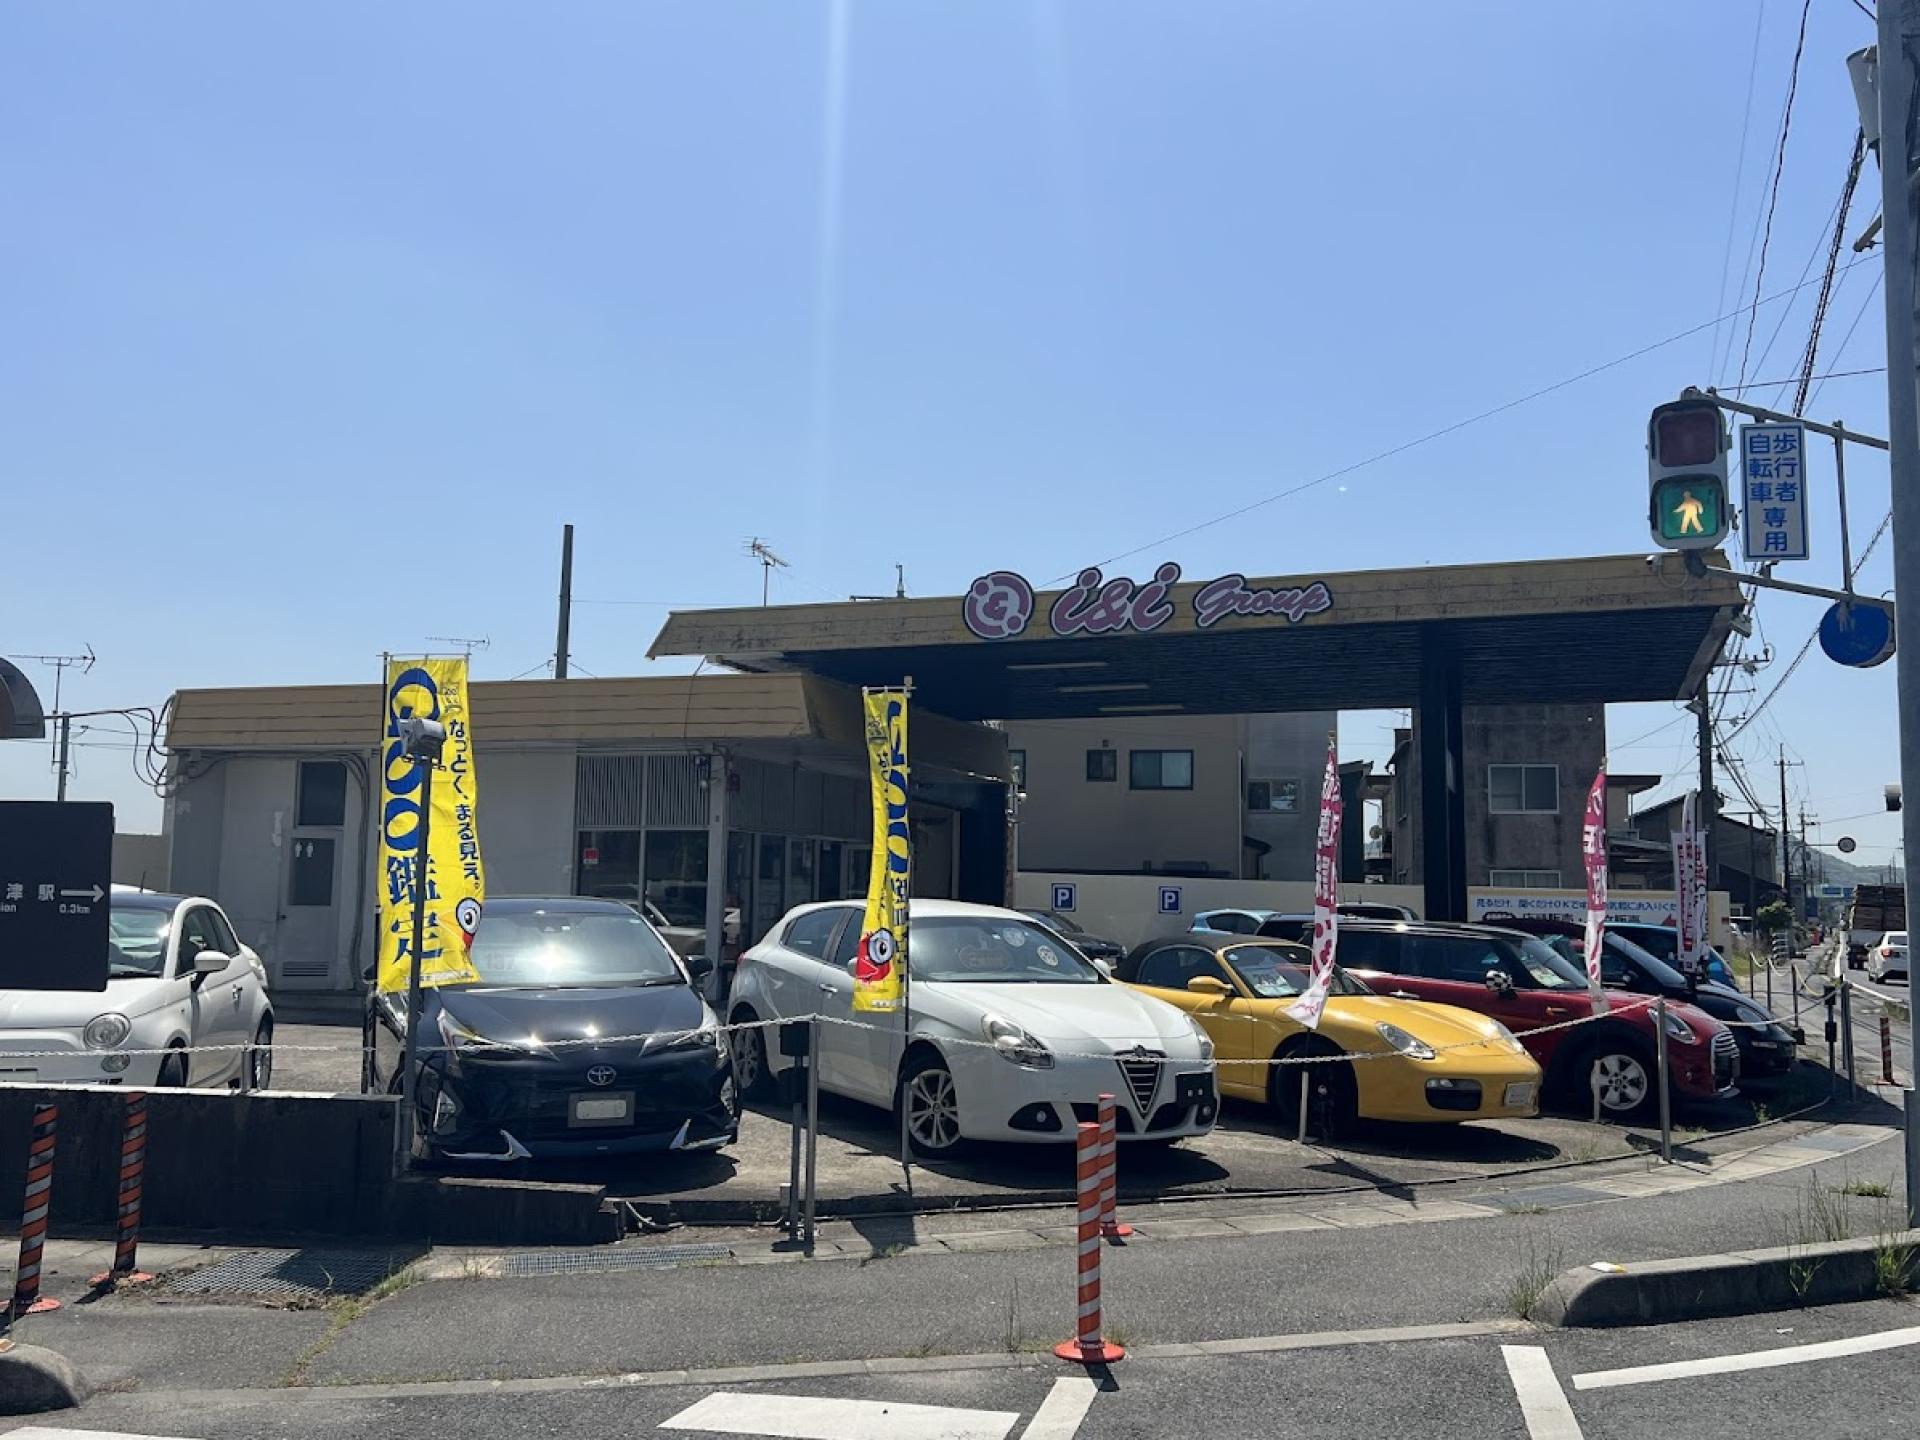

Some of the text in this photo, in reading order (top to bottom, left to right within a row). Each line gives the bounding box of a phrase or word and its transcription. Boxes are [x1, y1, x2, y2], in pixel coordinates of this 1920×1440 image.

[1748, 433, 1773, 504] 自転車
[1774, 432, 1799, 502] 歩行者
[1763, 507, 1788, 552] 専用
[1193, 573, 1333, 628] Group
[59, 903, 90, 914] 0.3km
